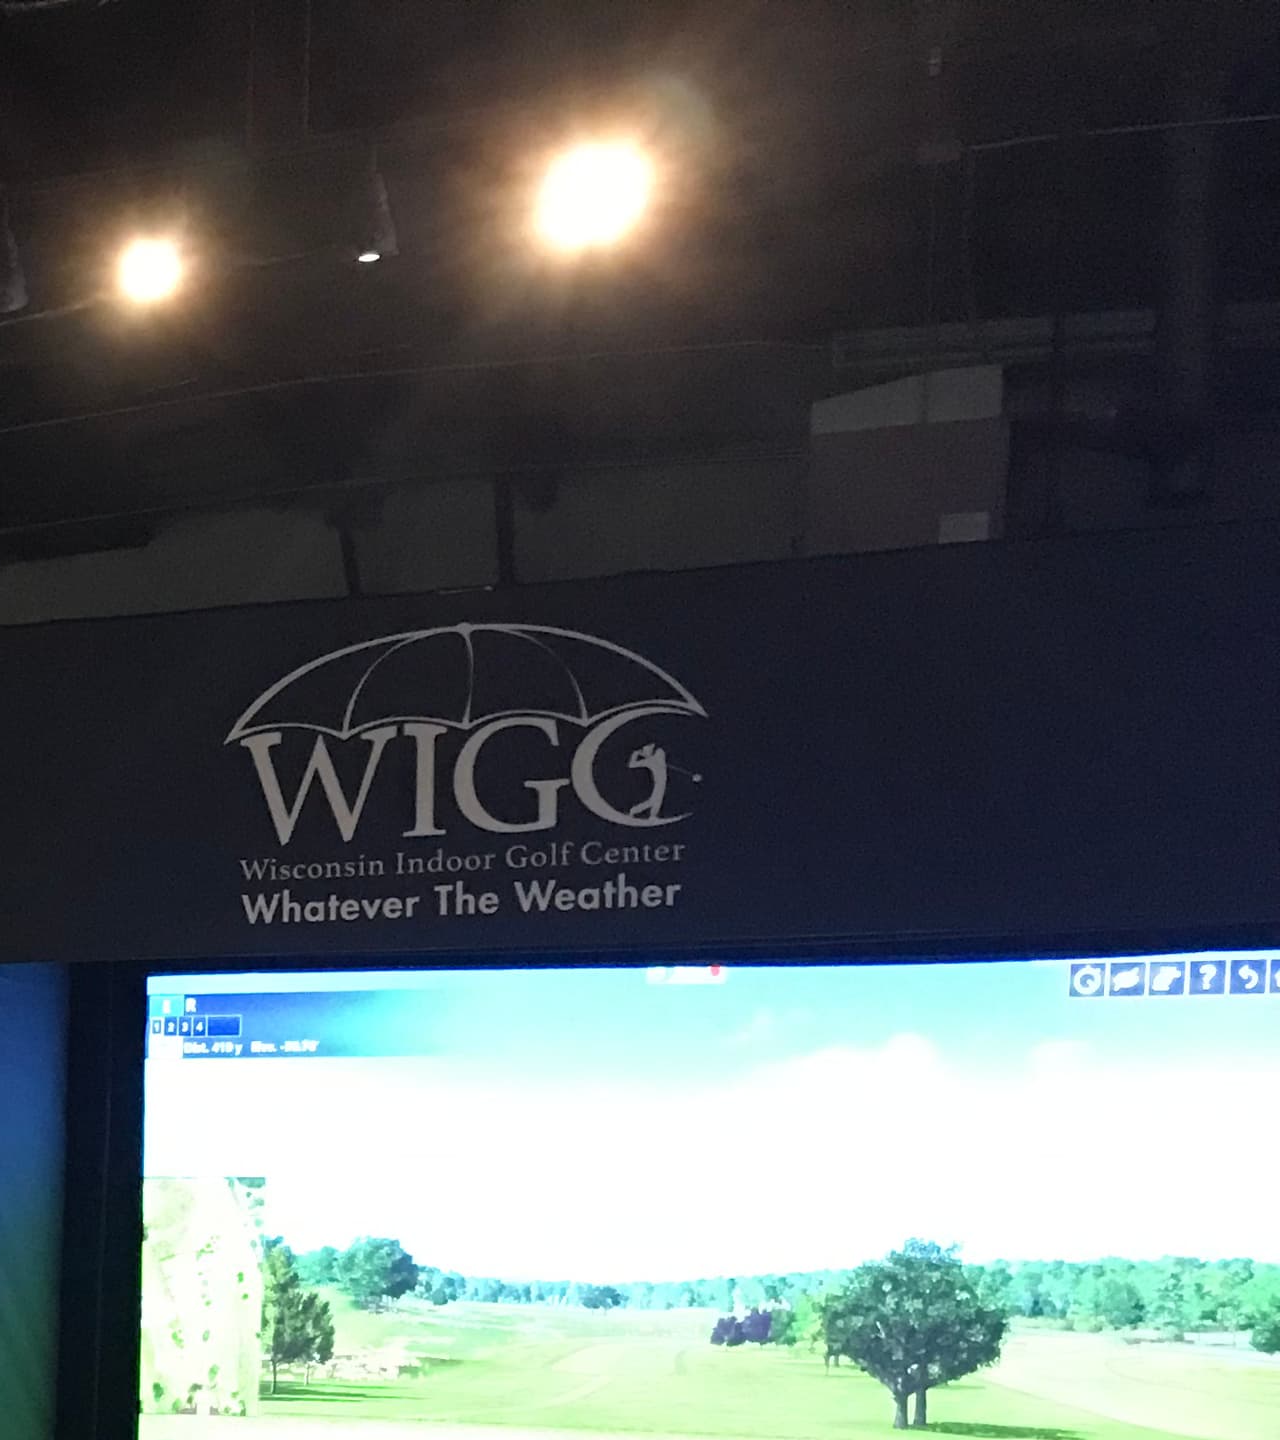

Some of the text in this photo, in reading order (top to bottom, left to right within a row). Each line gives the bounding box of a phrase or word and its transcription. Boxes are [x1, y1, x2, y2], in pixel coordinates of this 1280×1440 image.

[240, 840, 686, 883] Wisconsin Indoor Golf Center
[241, 873, 682, 925] Whatever The Weather
[195, 1022, 203, 1032] 4
